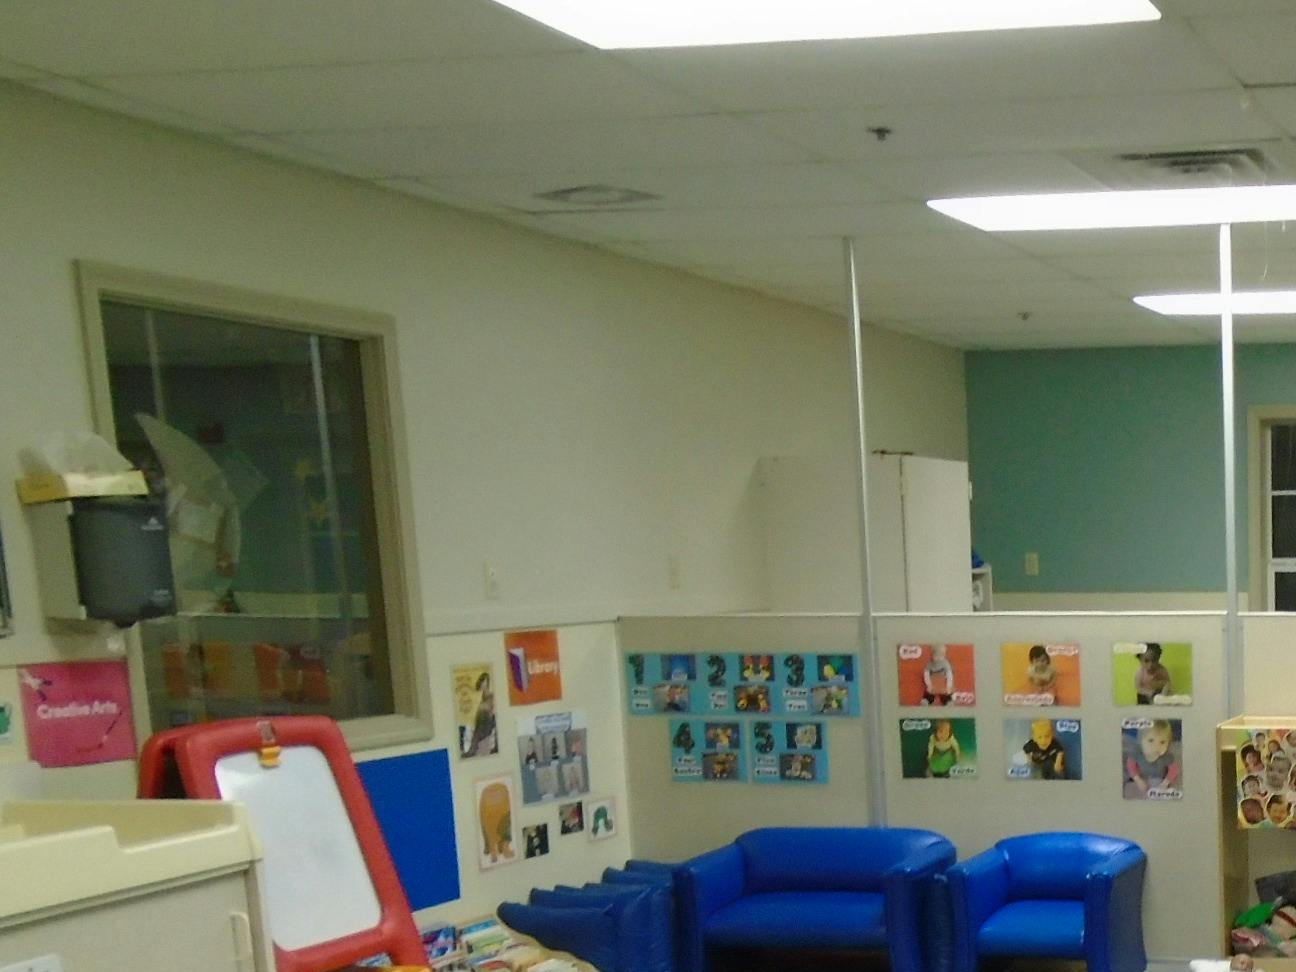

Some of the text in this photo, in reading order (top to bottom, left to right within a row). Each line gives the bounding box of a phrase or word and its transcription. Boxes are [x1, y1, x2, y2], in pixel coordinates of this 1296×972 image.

[528, 659, 560, 675] Library
[628, 654, 645, 685] 1
[706, 654, 726, 687] 2
[783, 654, 805, 687] 3
[37, 700, 118, 719] Creative Arts
[673, 722, 695, 755] 4
[753, 722, 774, 754] 5
